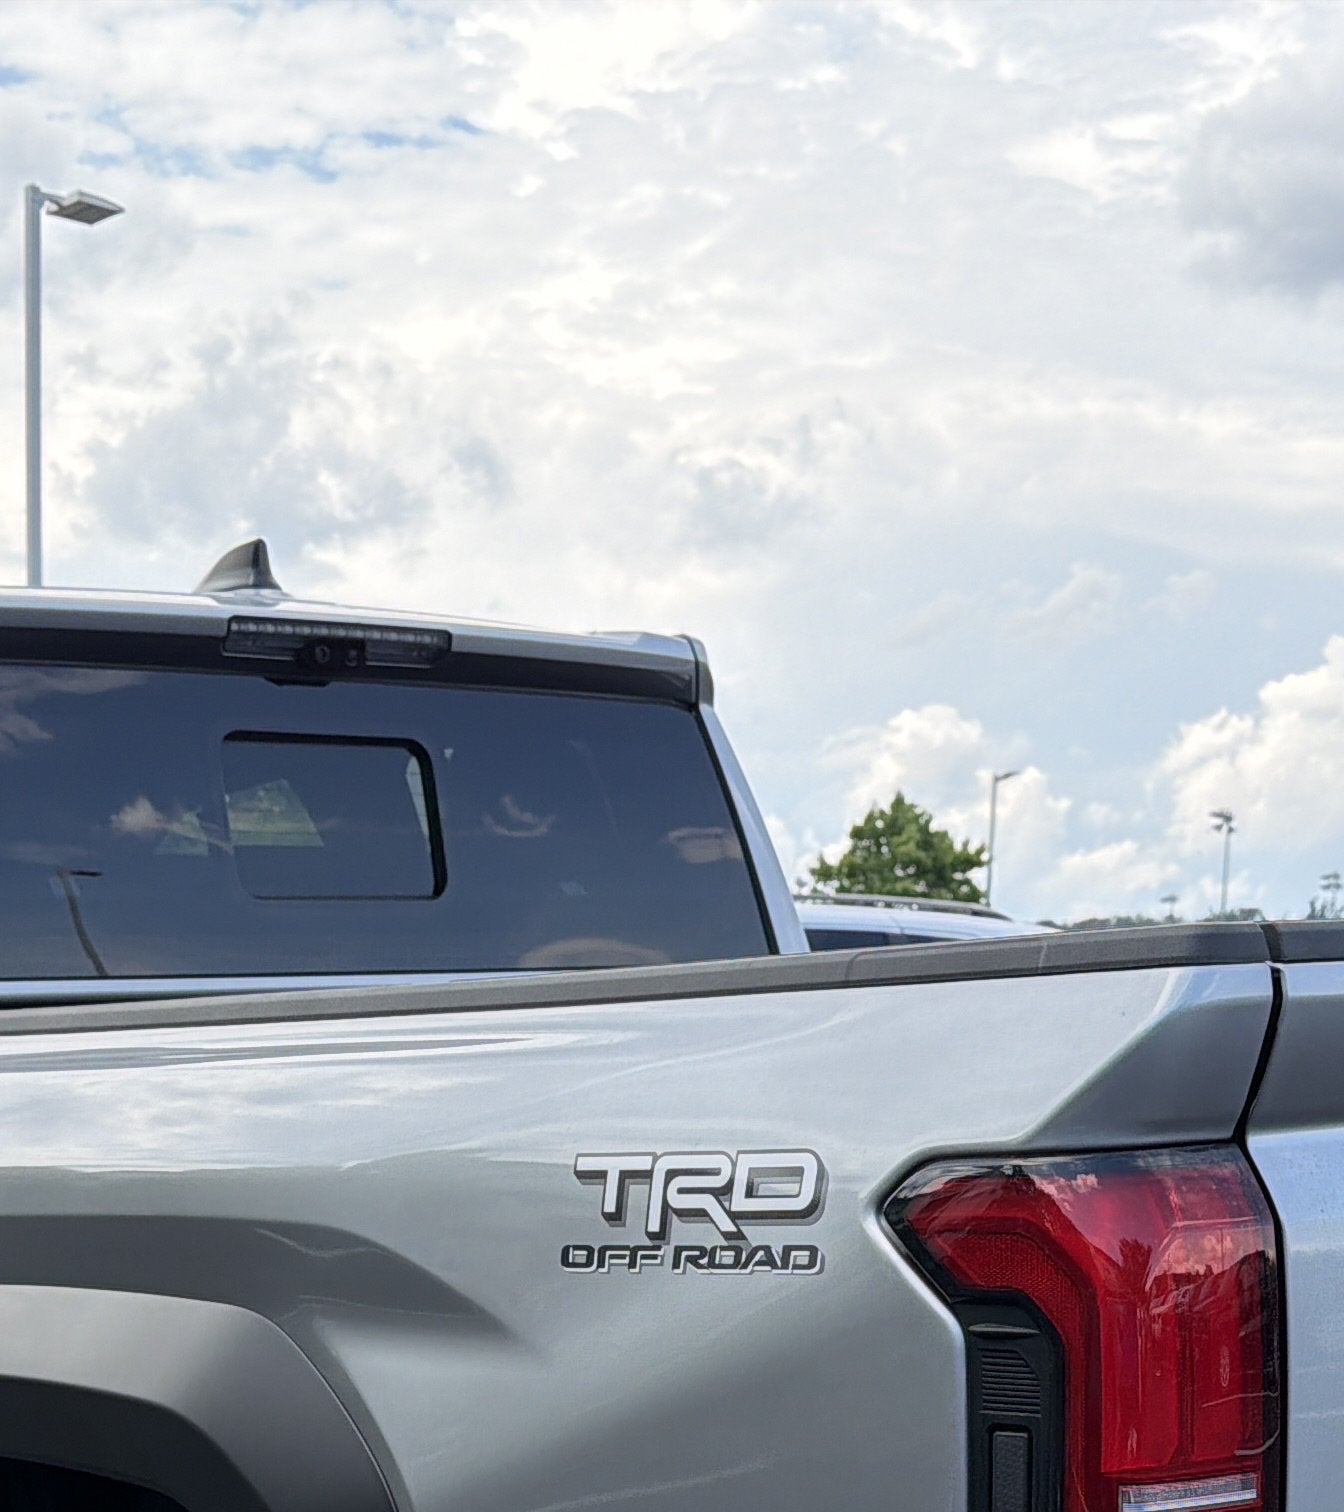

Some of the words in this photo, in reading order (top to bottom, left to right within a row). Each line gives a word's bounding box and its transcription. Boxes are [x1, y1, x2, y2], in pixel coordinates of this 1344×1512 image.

[573, 1148, 830, 1246] TRD
[561, 1244, 664, 1275] OFF
[672, 1244, 825, 1275] ROAD
